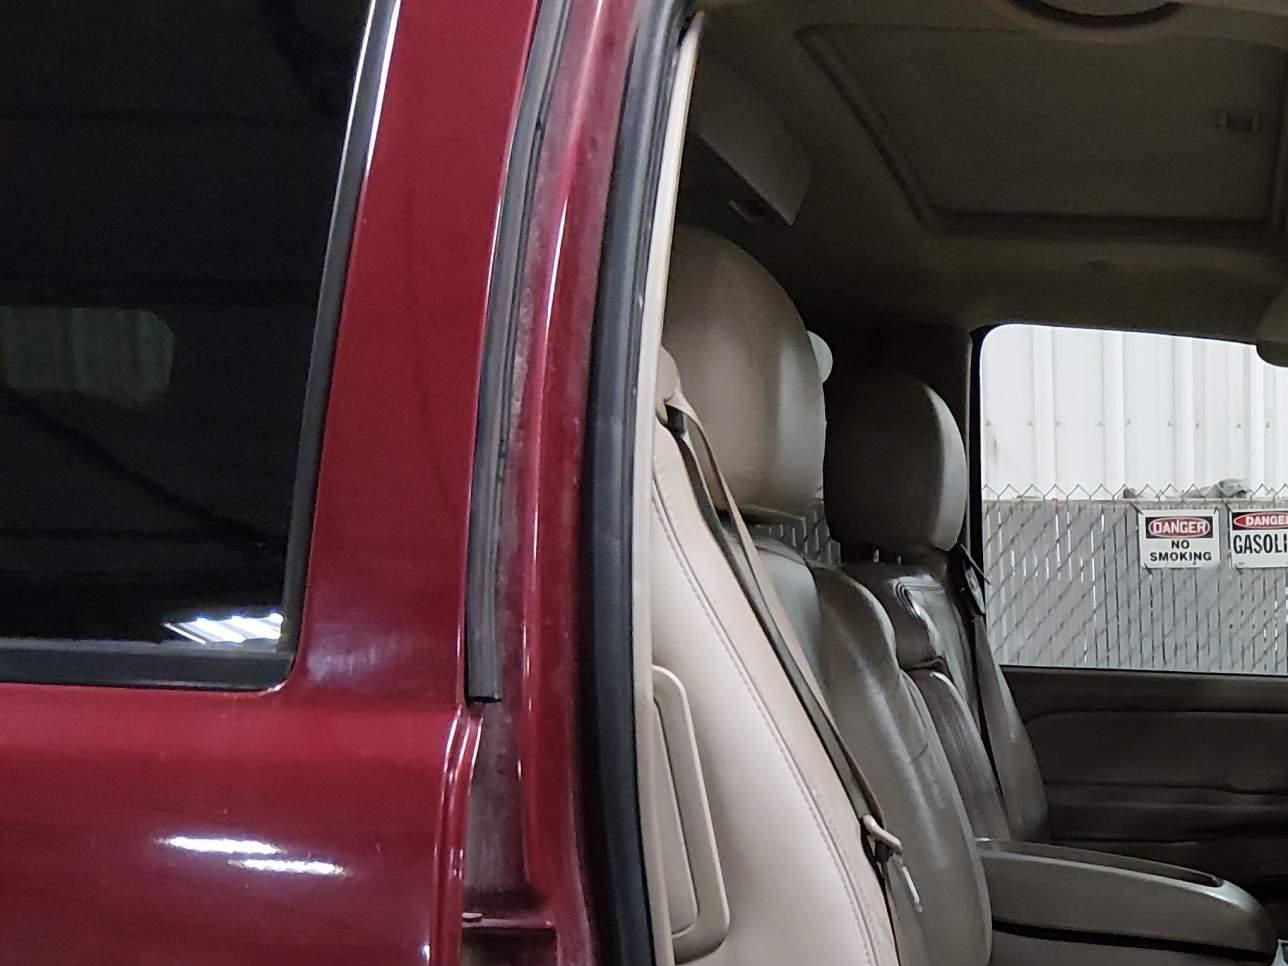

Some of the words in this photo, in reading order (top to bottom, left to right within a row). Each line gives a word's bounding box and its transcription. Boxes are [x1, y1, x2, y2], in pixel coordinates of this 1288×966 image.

[1153, 520, 1206, 534] DANGER
[1171, 540, 1190, 550] NO
[1149, 551, 1212, 562] SMOKING
